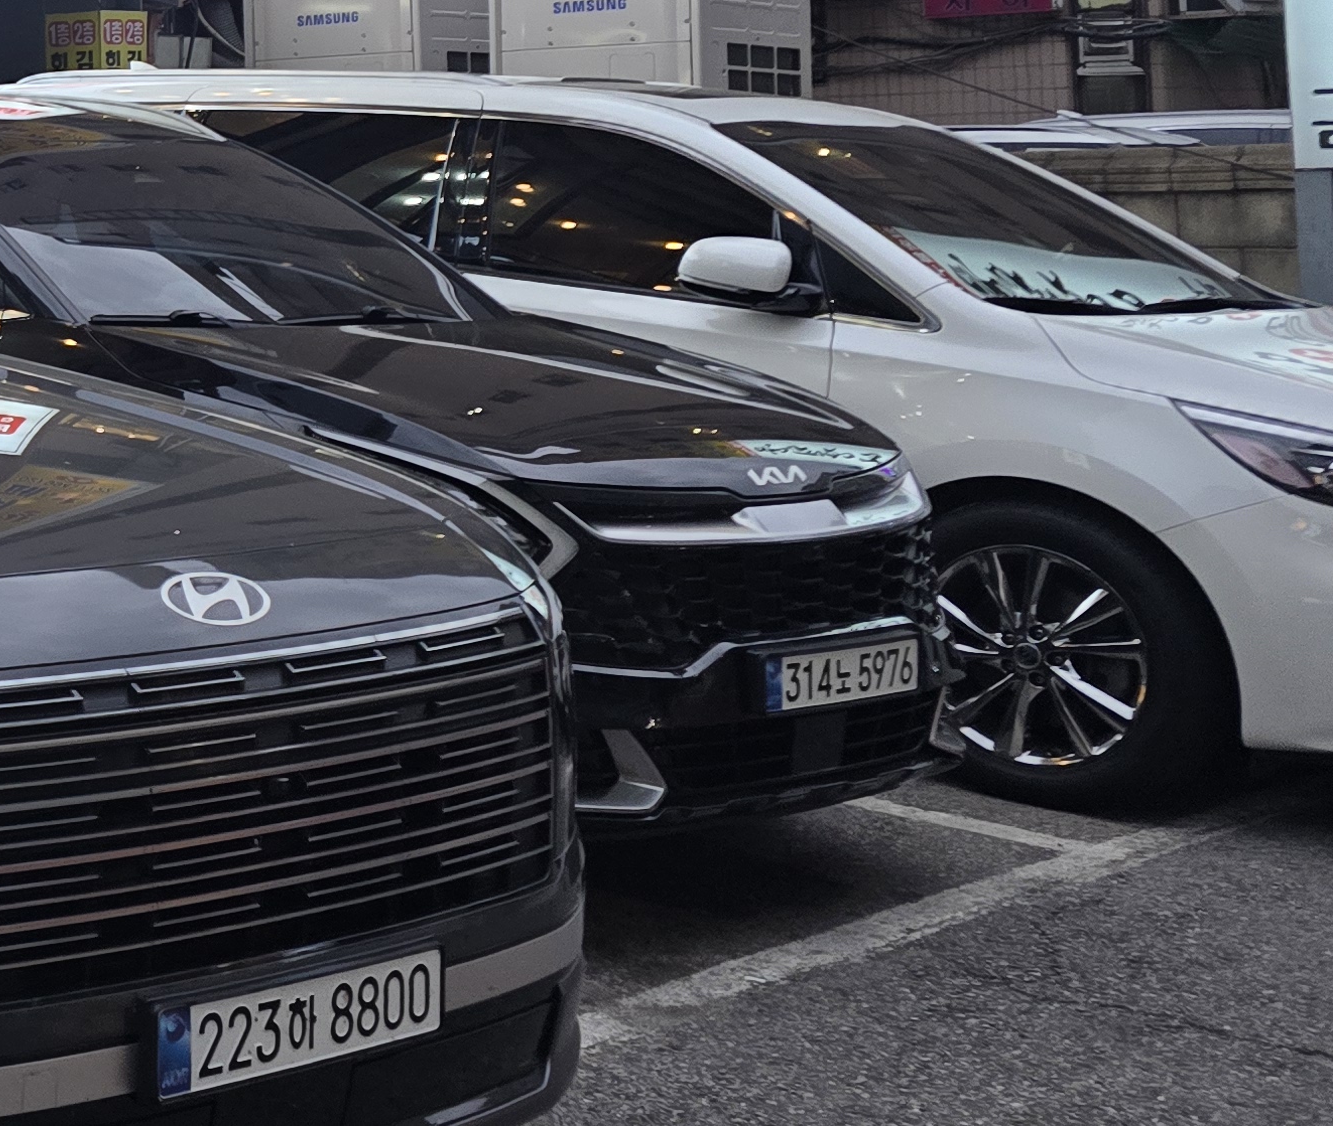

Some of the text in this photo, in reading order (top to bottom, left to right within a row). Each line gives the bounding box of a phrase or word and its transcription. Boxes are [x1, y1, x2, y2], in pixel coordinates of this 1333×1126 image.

[296, 10, 359, 28] SAMSUNG
[50, 21, 94, 46] 1층 2층
[103, 20, 144, 45] 1층 2층
[747, 465, 807, 486] KIA
[785, 646, 913, 703] 314노 5976
[198, 962, 431, 1079] 223하 8800
